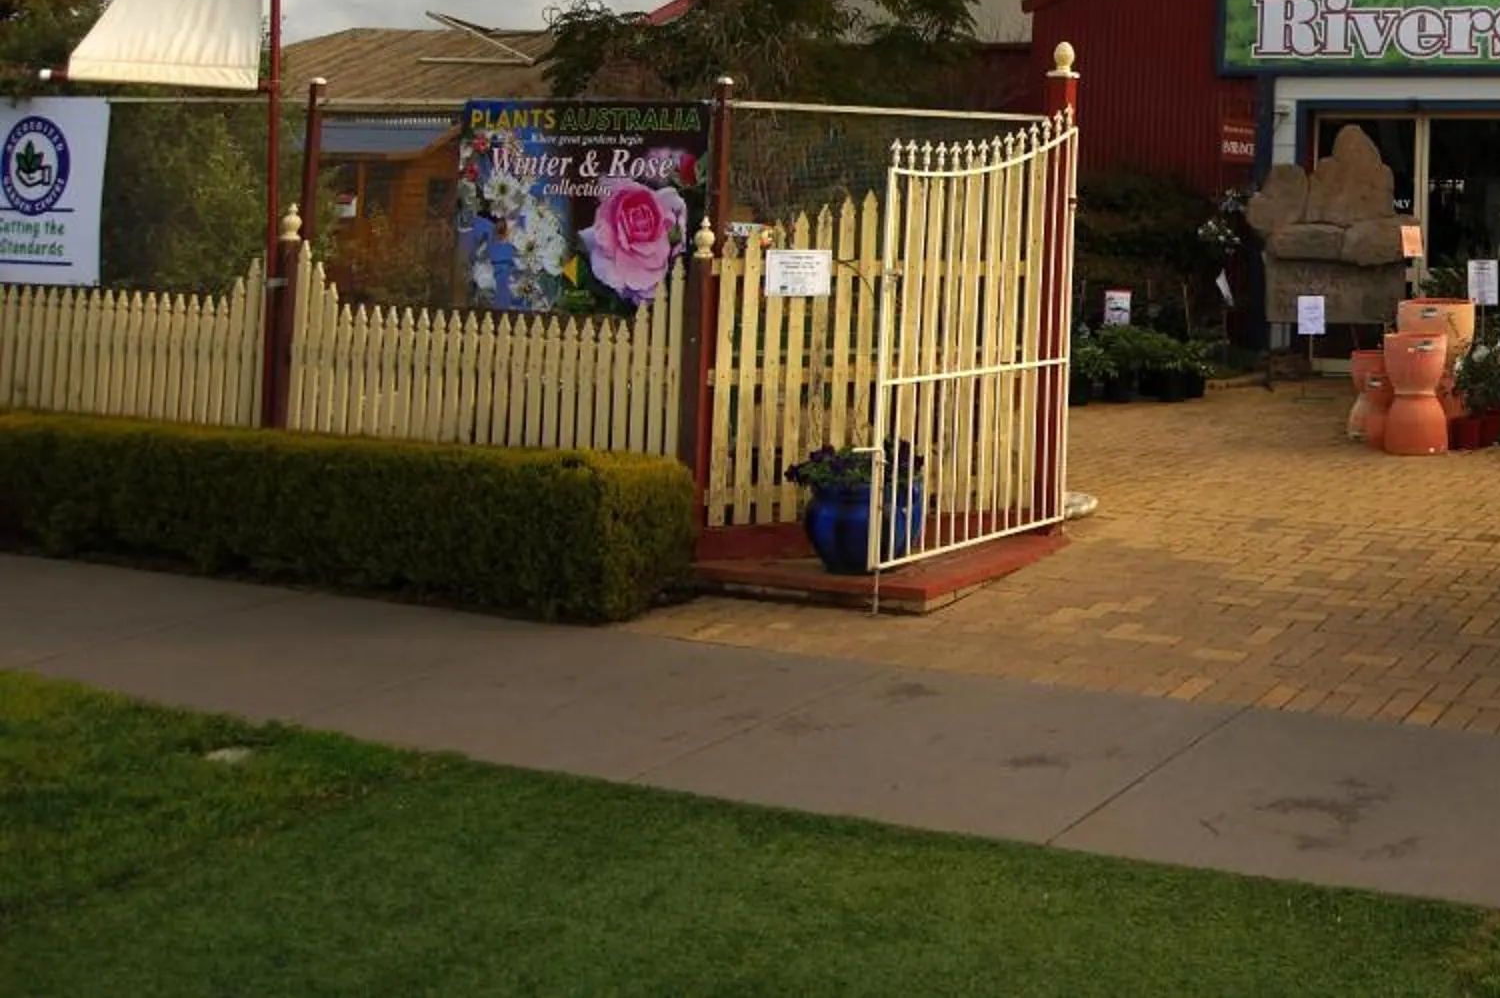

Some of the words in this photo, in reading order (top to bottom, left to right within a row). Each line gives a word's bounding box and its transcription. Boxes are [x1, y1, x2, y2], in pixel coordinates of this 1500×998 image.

[470, 108, 555, 129] PLANTS
[559, 107, 701, 131] AUSTRALIA
[492, 148, 573, 177] Winter
[579, 149, 599, 177] &
[607, 149, 673, 177] Rose
[542, 181, 613, 198] collection
